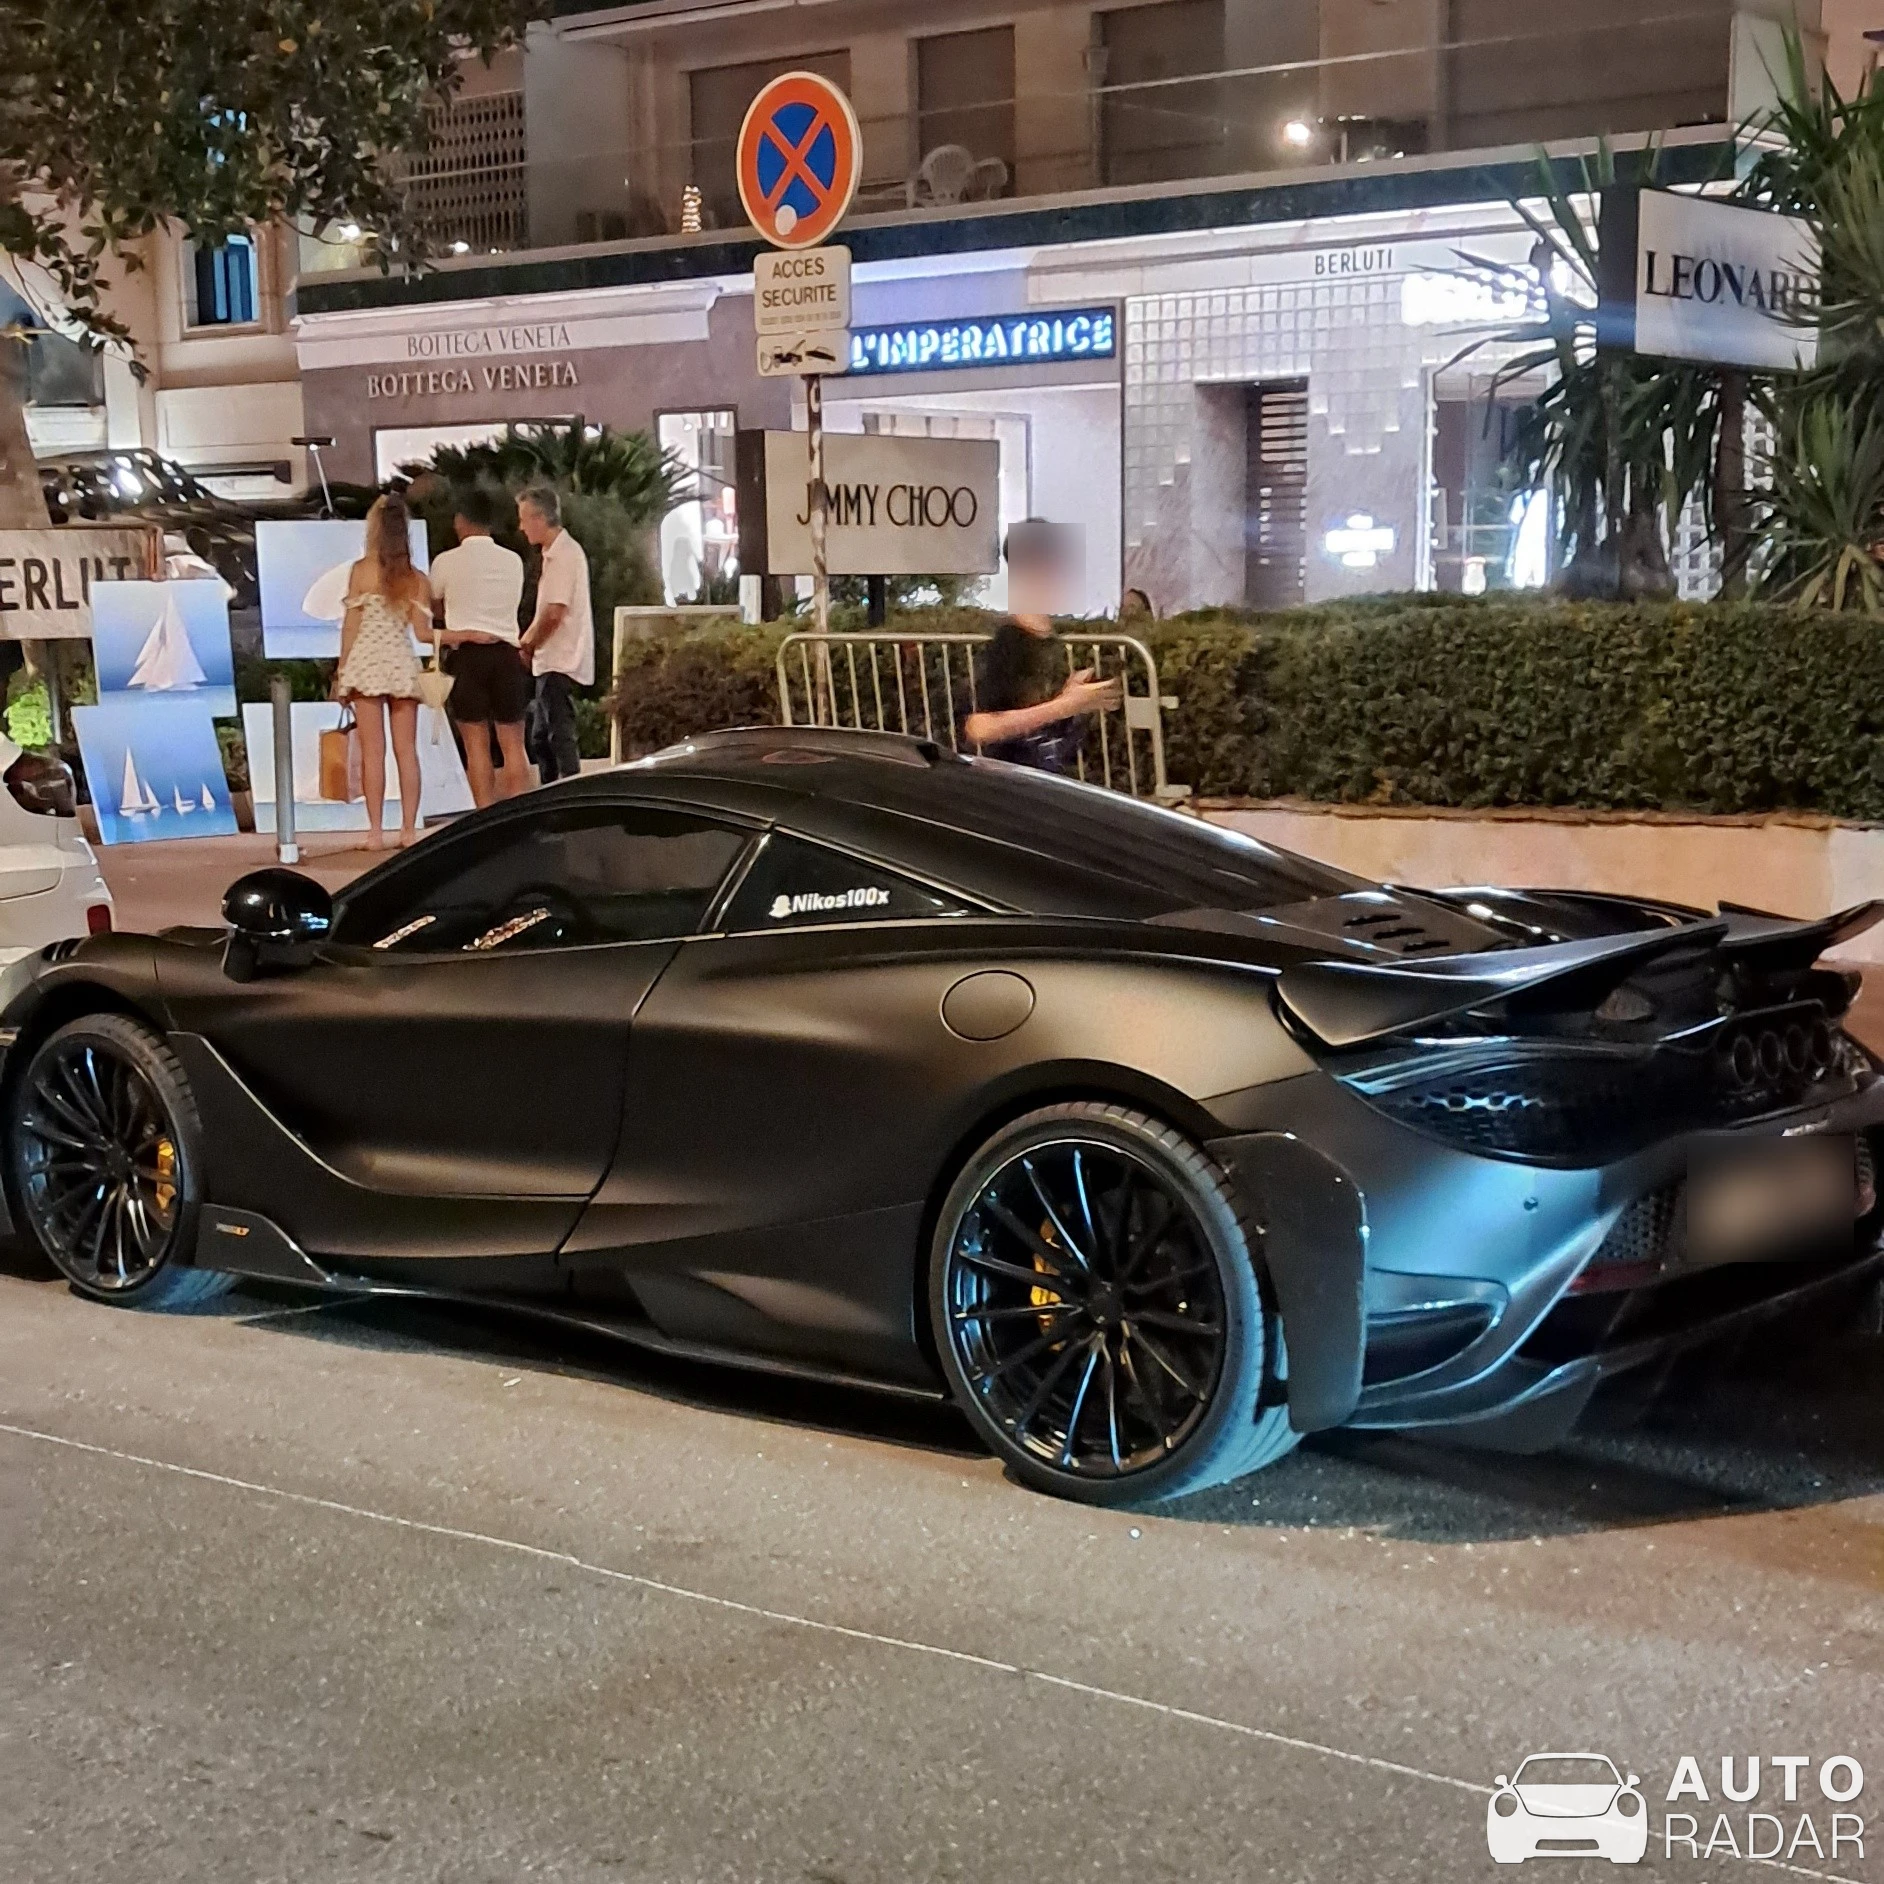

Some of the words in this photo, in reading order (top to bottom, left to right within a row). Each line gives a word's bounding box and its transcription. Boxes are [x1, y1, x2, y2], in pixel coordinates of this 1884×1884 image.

[772, 256, 825, 279] ACCES
[1314, 249, 1393, 275] BERLUTI
[761, 283, 837, 308] SECURITE
[407, 331, 492, 357] BOTTEGA
[498, 324, 571, 350] VENETA
[851, 314, 1113, 369] L'IMPERATRICE
[367, 368, 475, 398] BOTTEGA
[482, 361, 579, 390] VENETA
[796, 484, 879, 526] JMMY
[886, 484, 977, 527] CHOO
[792, 887, 890, 913] Nikos100x
